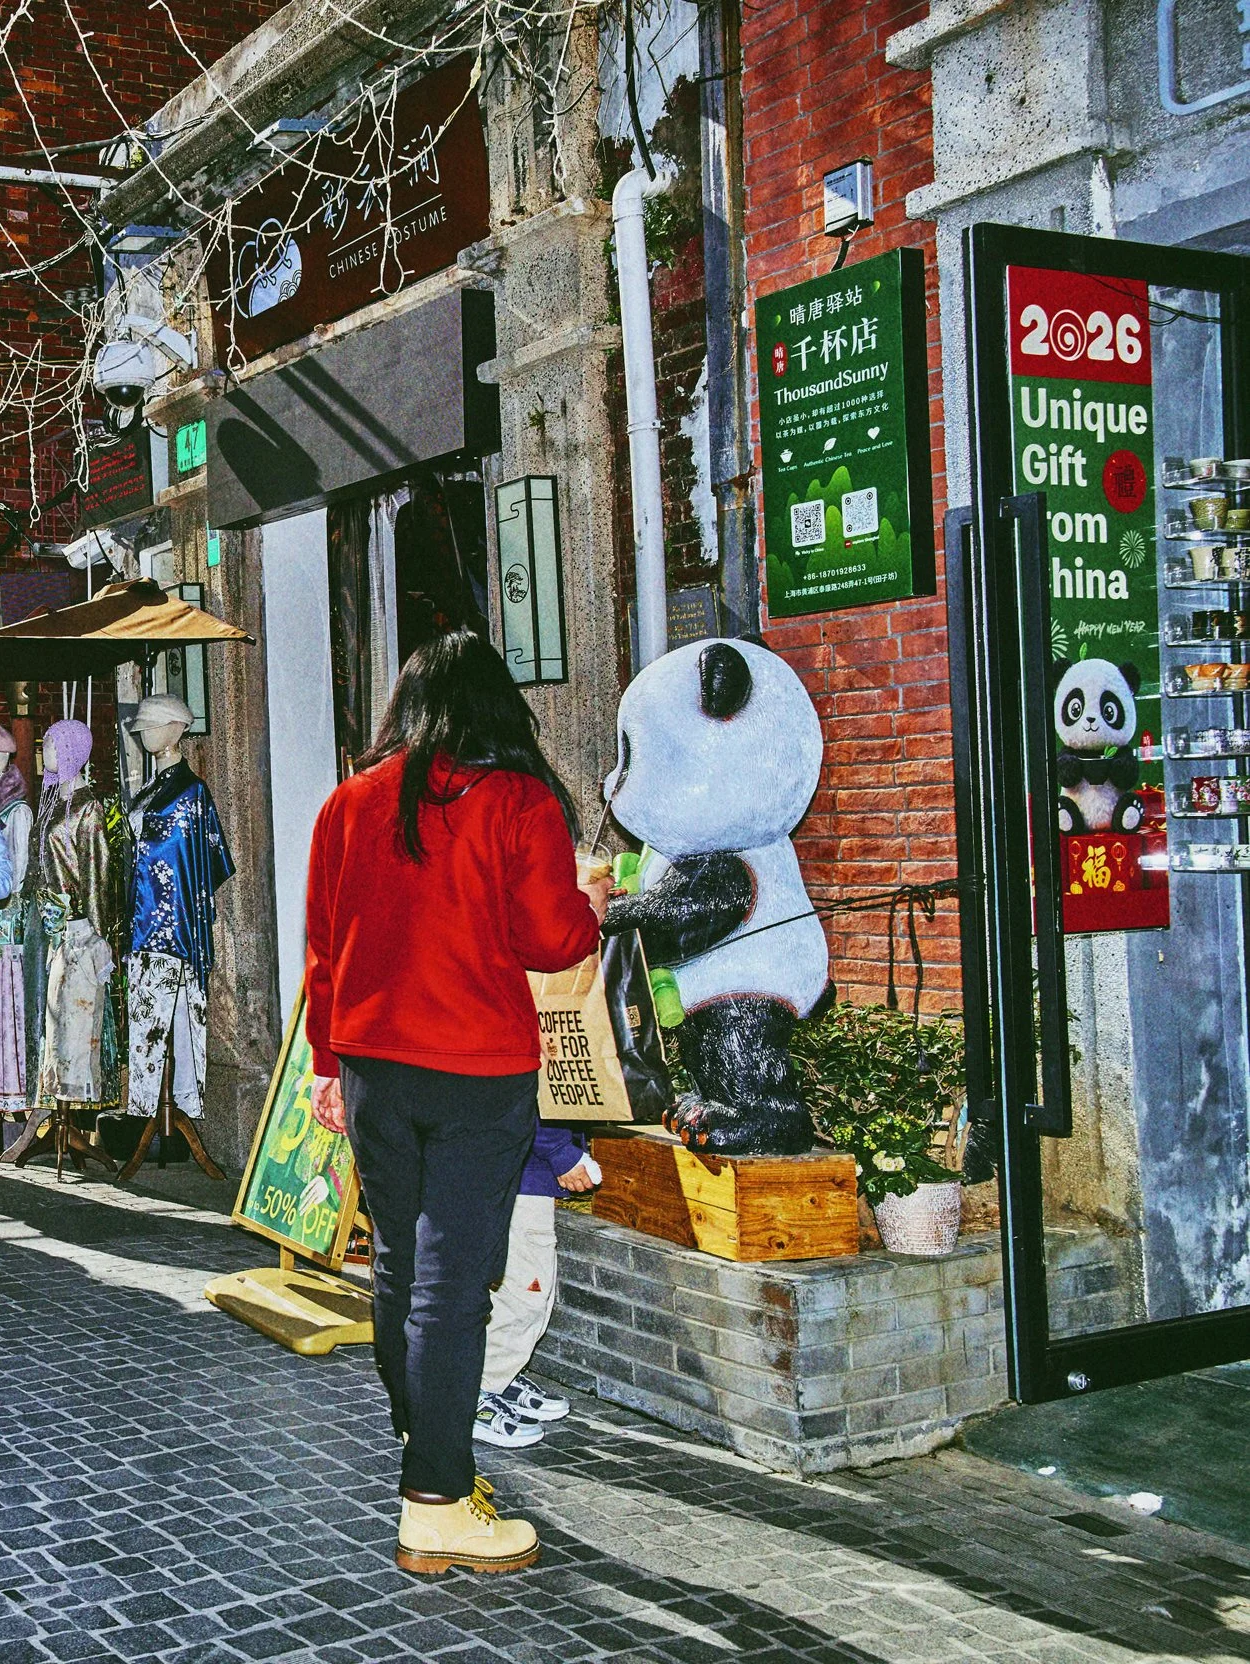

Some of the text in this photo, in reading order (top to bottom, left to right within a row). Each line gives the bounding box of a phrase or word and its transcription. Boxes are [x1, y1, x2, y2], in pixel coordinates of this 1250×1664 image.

[329, 206, 447, 279] CHINESE COSTUME
[789, 284, 863, 326] 晴唐驿站
[774, 346, 785, 374] 晴唐
[790, 317, 879, 372] 千杯店
[773, 361, 889, 406] ThousandSunny
[1020, 386, 1148, 443] Unique
[183, 426, 199, 453] 47
[1021, 444, 1087, 487] Gift
[1049, 512, 1107, 543] om
[1053, 558, 1129, 600] hina
[1074, 620, 1147, 640] HAPPY NEW YEAR
[1081, 845, 1111, 889] 福
[538, 1010, 586, 1034] COFFEE
[560, 1036, 591, 1058] FOR
[547, 1060, 597, 1082] COFFEE
[550, 1084, 604, 1106] PEOPLE
[260, 1185, 297, 1226] 50%
[303, 1203, 338, 1243] OFF
